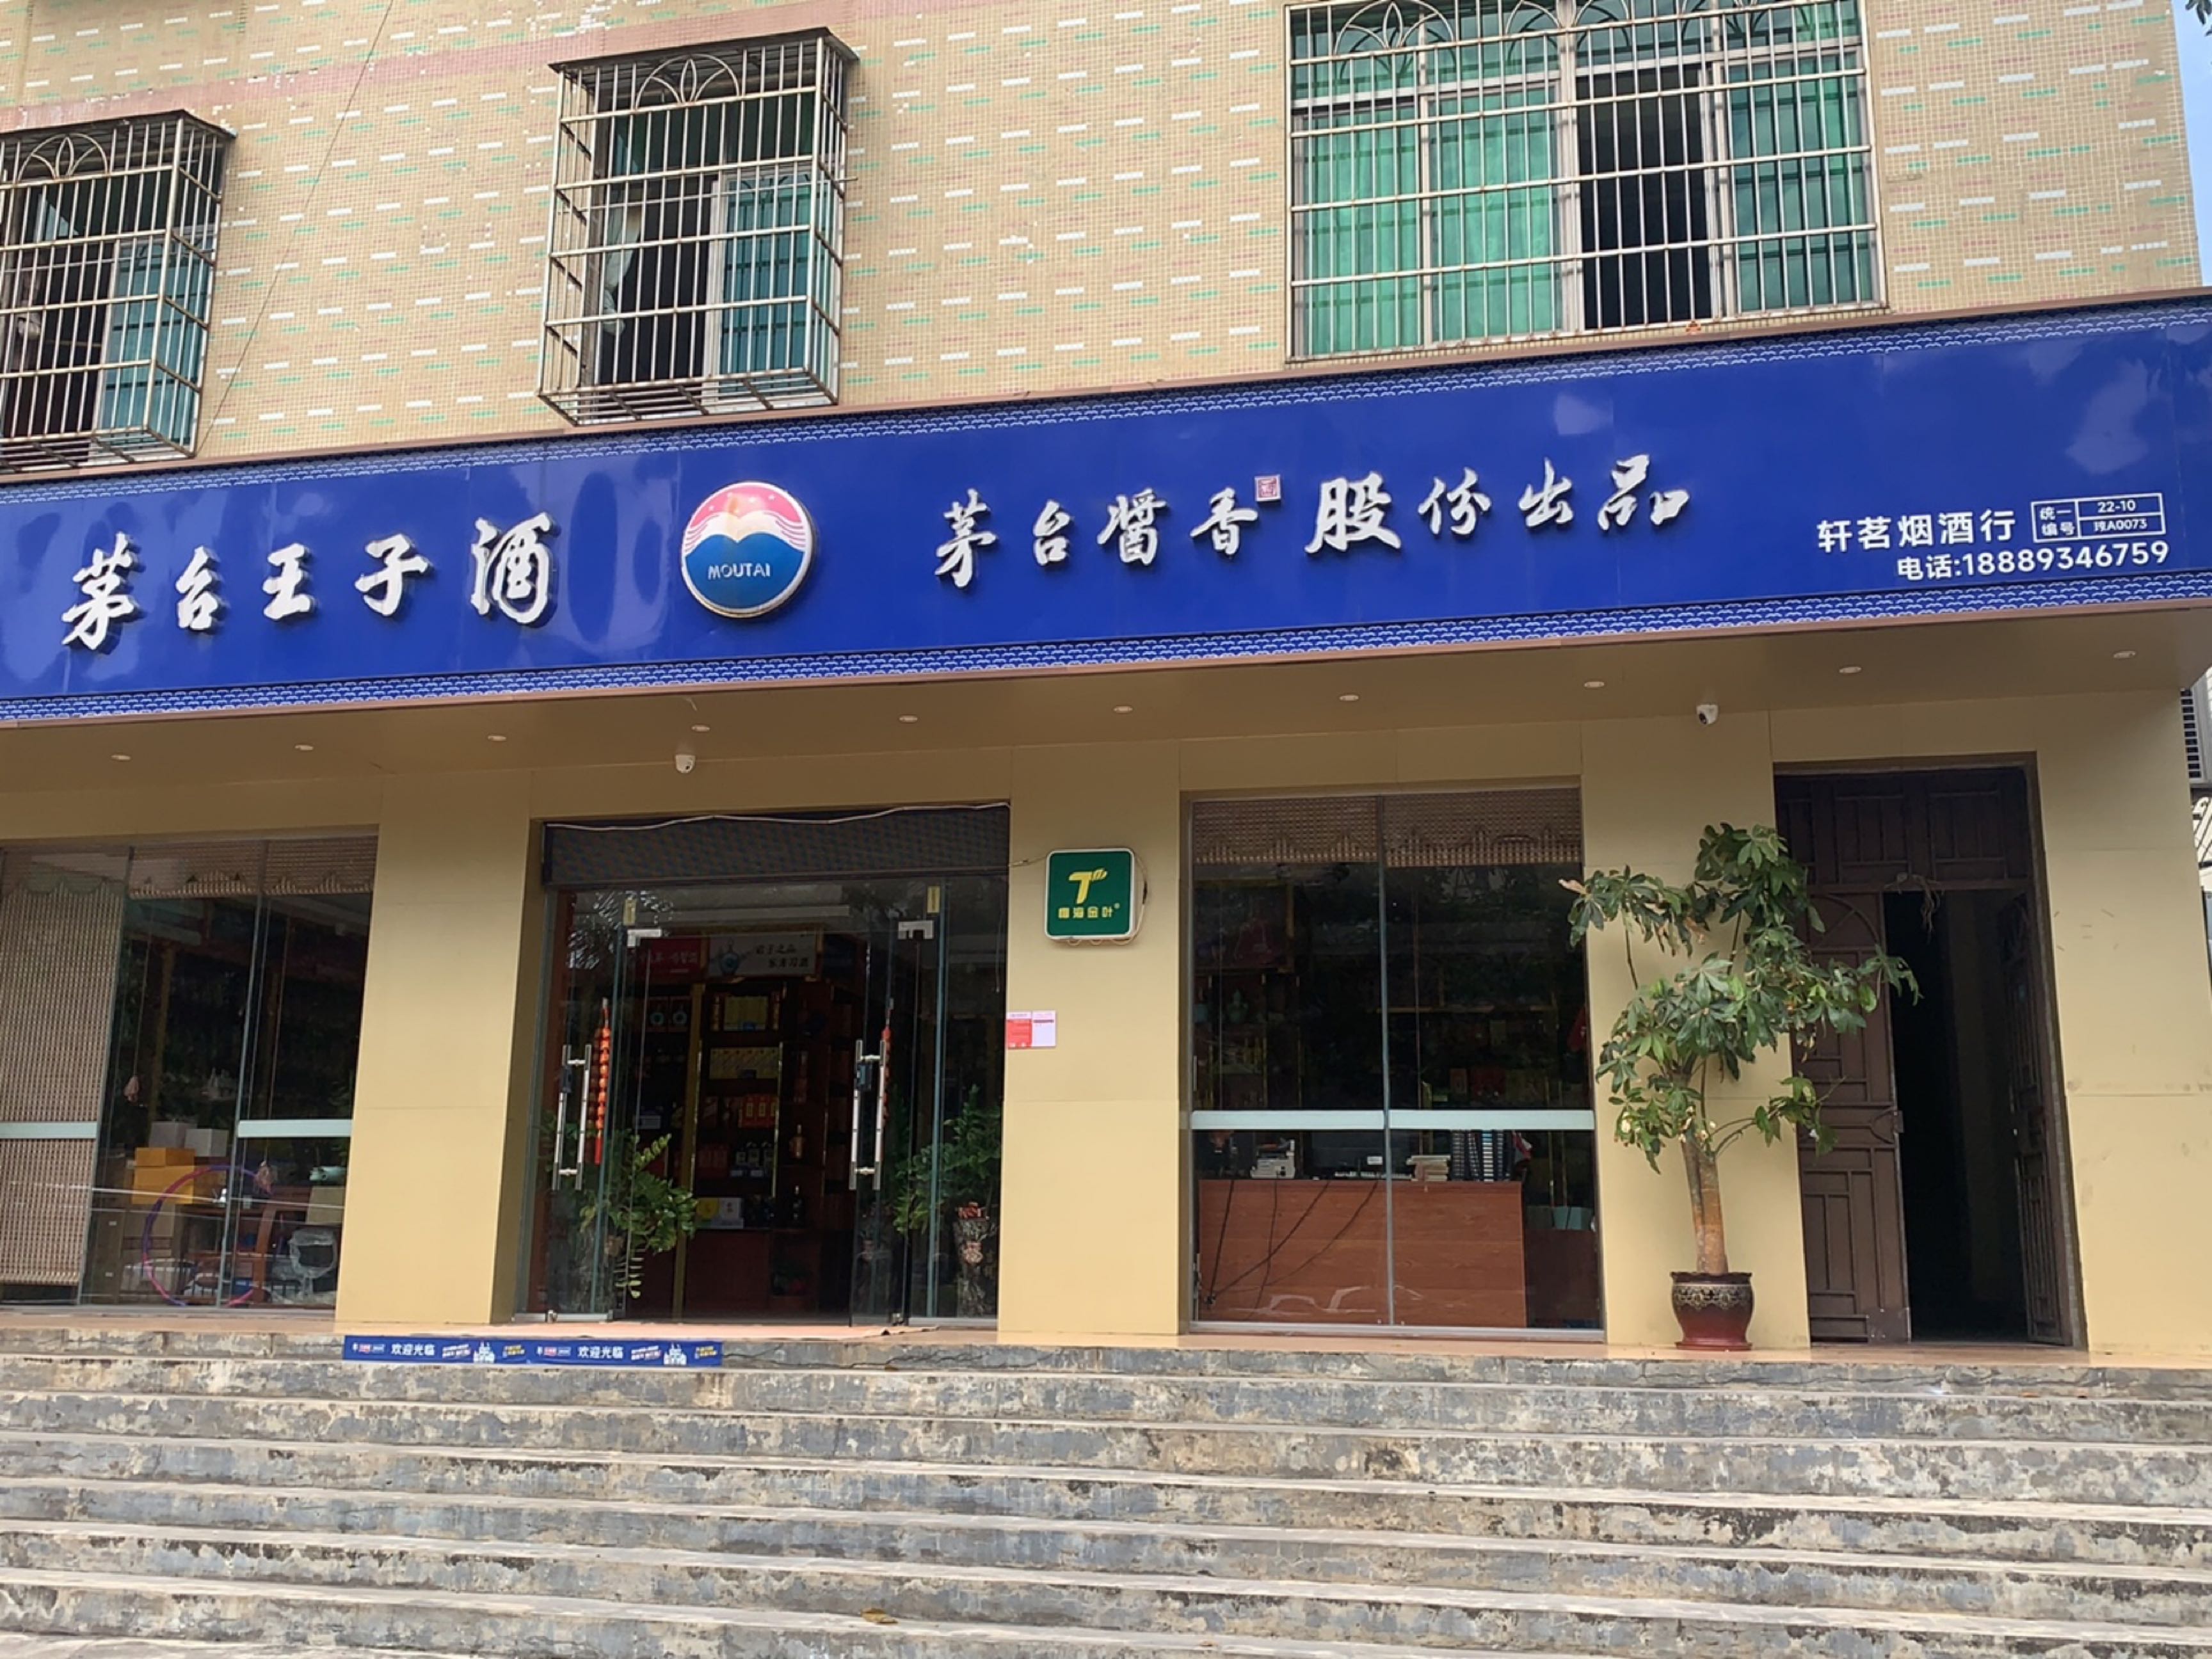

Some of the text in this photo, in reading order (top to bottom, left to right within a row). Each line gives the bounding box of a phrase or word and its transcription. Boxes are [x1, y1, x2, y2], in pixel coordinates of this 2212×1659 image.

[2097, 499, 2136, 513] 22-10
[1817, 509, 2016, 553] 轩茗烟酒行
[708, 563, 771, 580] MOUTAI
[62, 512, 550, 650] 茅台王子酒
[391, 1343, 435, 1356] 欢迎光临
[577, 1346, 624, 1359] 欢迎光临
